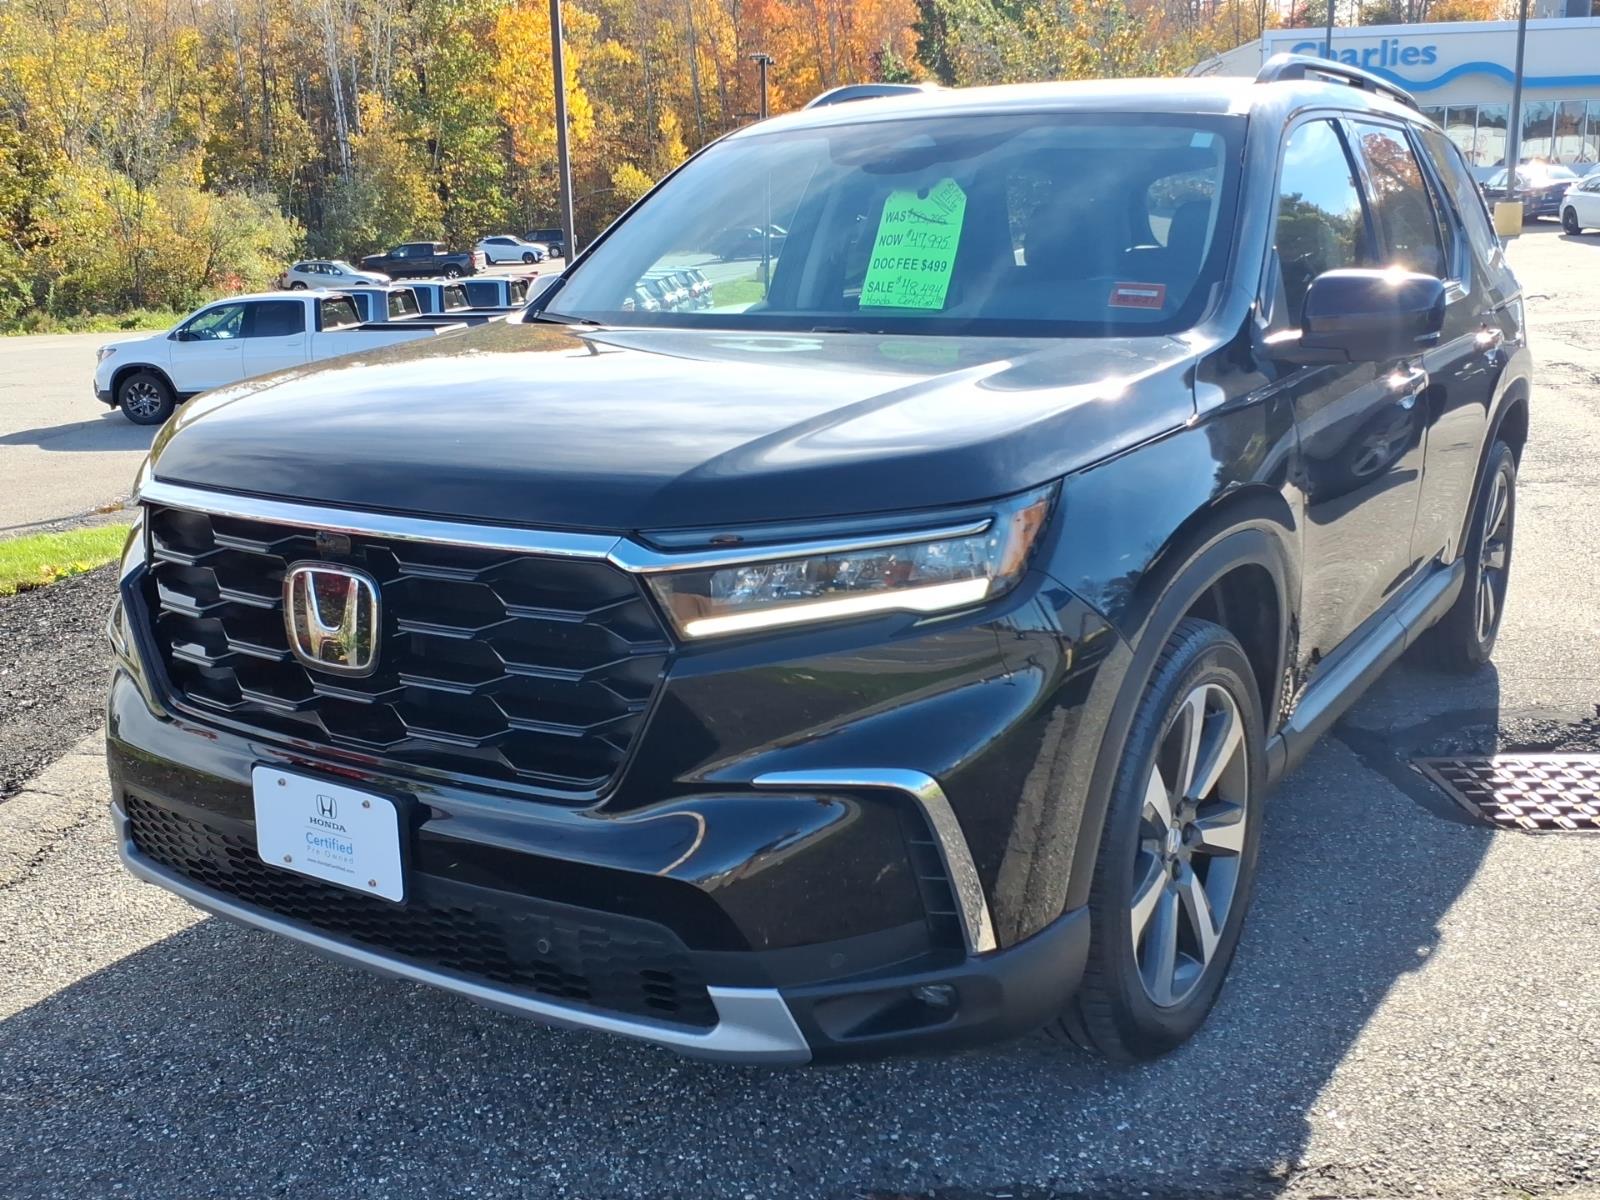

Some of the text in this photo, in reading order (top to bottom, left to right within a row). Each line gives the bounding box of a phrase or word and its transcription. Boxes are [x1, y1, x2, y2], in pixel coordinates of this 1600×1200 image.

[885, 210, 907, 223] WAS
[879, 234, 904, 247] NOW
[873, 258, 948, 272] DOC FEE $499
[867, 281, 895, 293] SALE
[309, 817, 346, 832] HONDA
[306, 832, 353, 855] Certified
